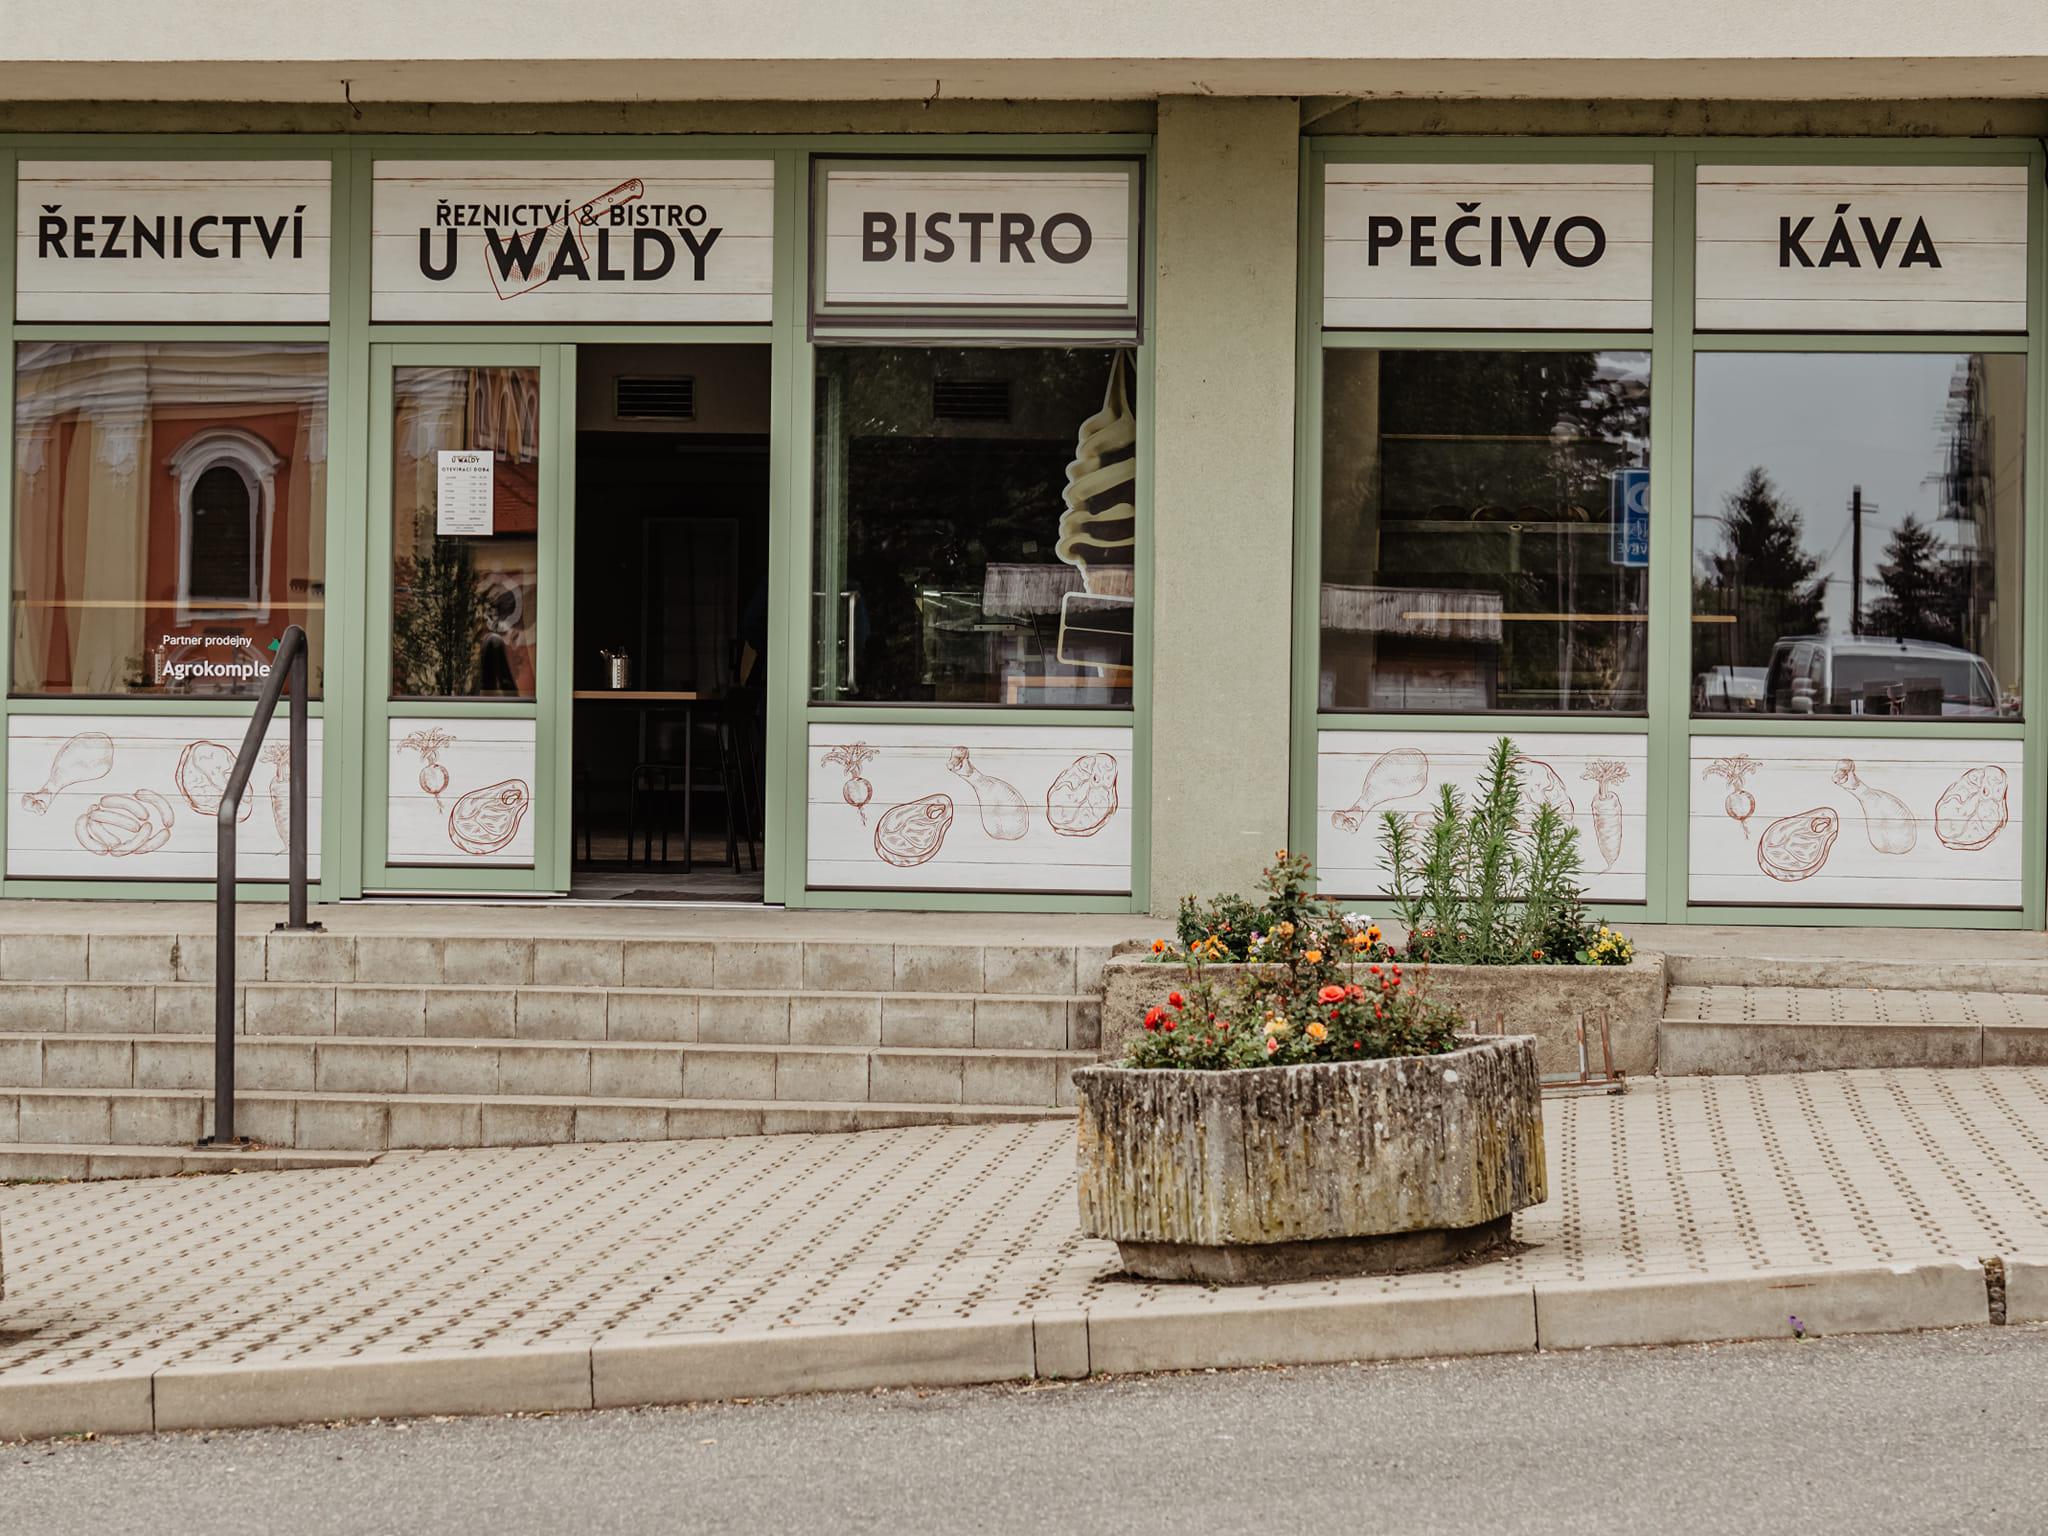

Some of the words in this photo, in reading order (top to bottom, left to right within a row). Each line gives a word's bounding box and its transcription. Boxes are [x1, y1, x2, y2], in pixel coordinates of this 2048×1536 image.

[38, 204, 307, 260] ŘEZNICTVÍ
[436, 198, 570, 227] ŘEZNICTVÍ
[580, 204, 600, 227] &
[609, 204, 707, 227] BISTRO
[862, 211, 1092, 264] BISTRO
[1367, 202, 1608, 268] PEČIVO
[1779, 203, 1942, 269] KÁVA
[419, 227, 458, 282] U
[484, 227, 723, 282] WALDY
[162, 634, 203, 646] Partner
[205, 634, 253, 648] prodejny
[161, 660, 273, 681] Agrokomple
